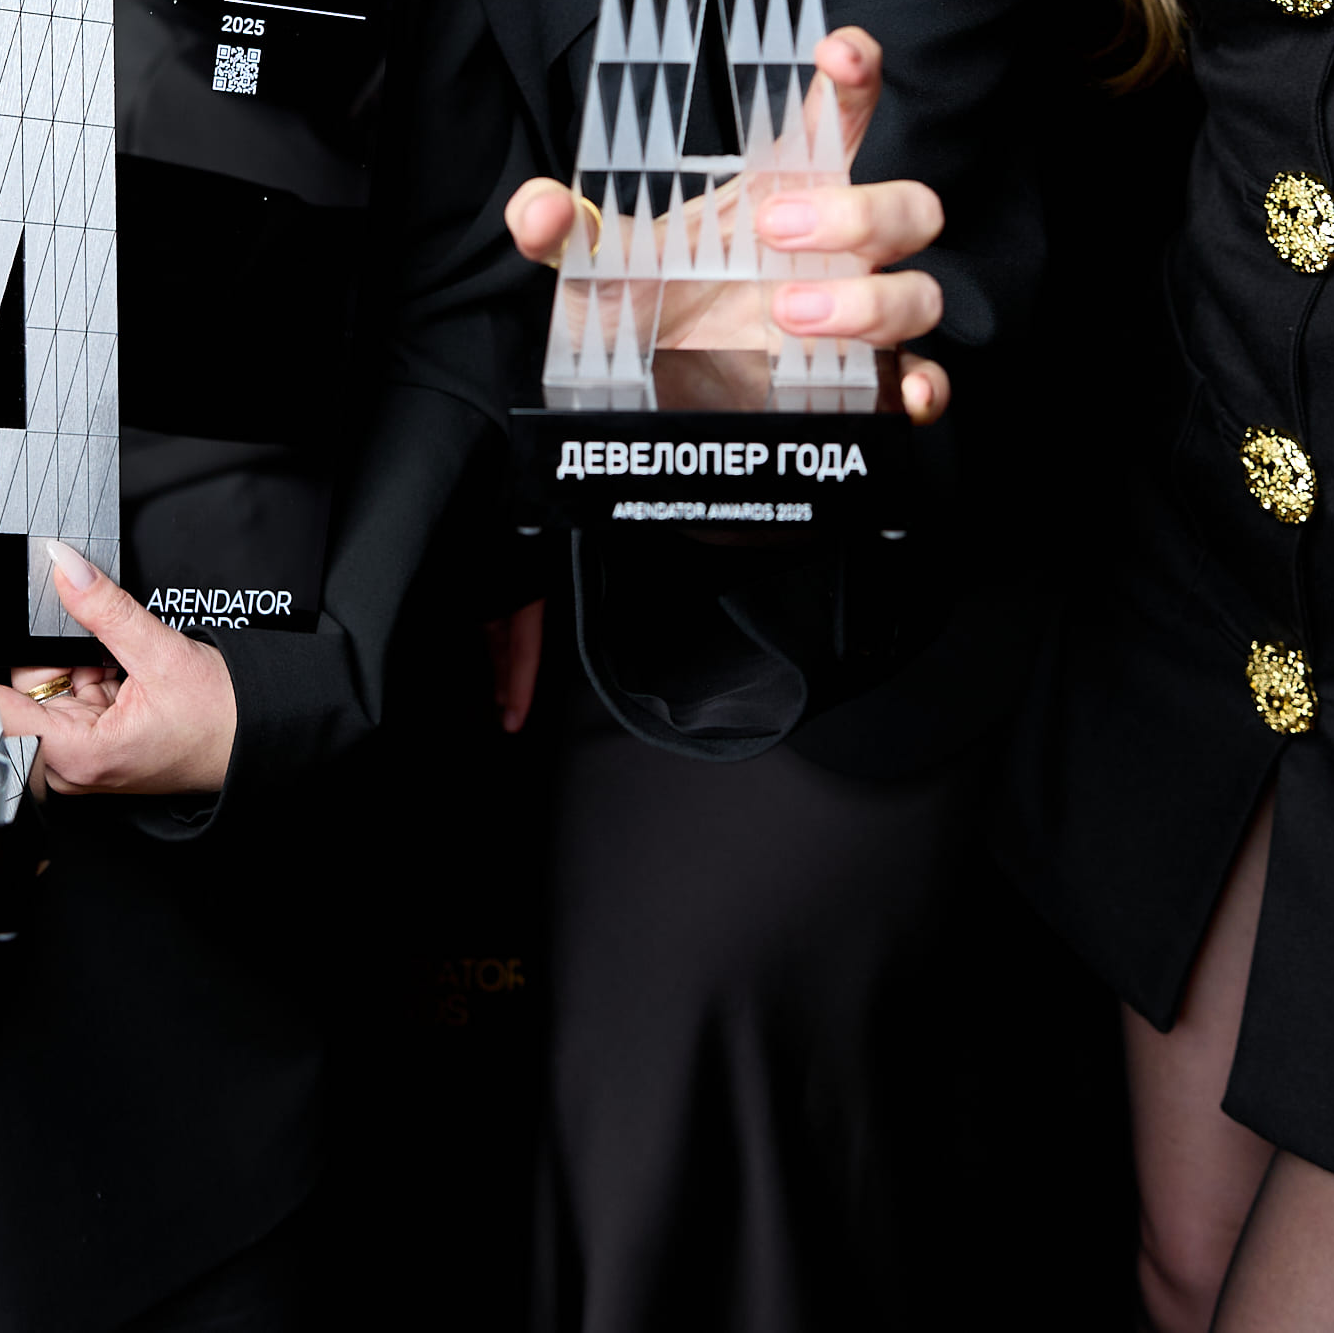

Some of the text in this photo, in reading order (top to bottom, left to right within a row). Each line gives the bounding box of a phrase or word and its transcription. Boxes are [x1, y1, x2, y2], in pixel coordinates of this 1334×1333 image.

[221, 15, 265, 36] 2025
[556, 441, 868, 482] ДЕВЕЛОПЕР ГОДА
[612, 501, 813, 522] ARENDATOR AWARDS 2025
[146, 587, 293, 615] ARENDATOR
